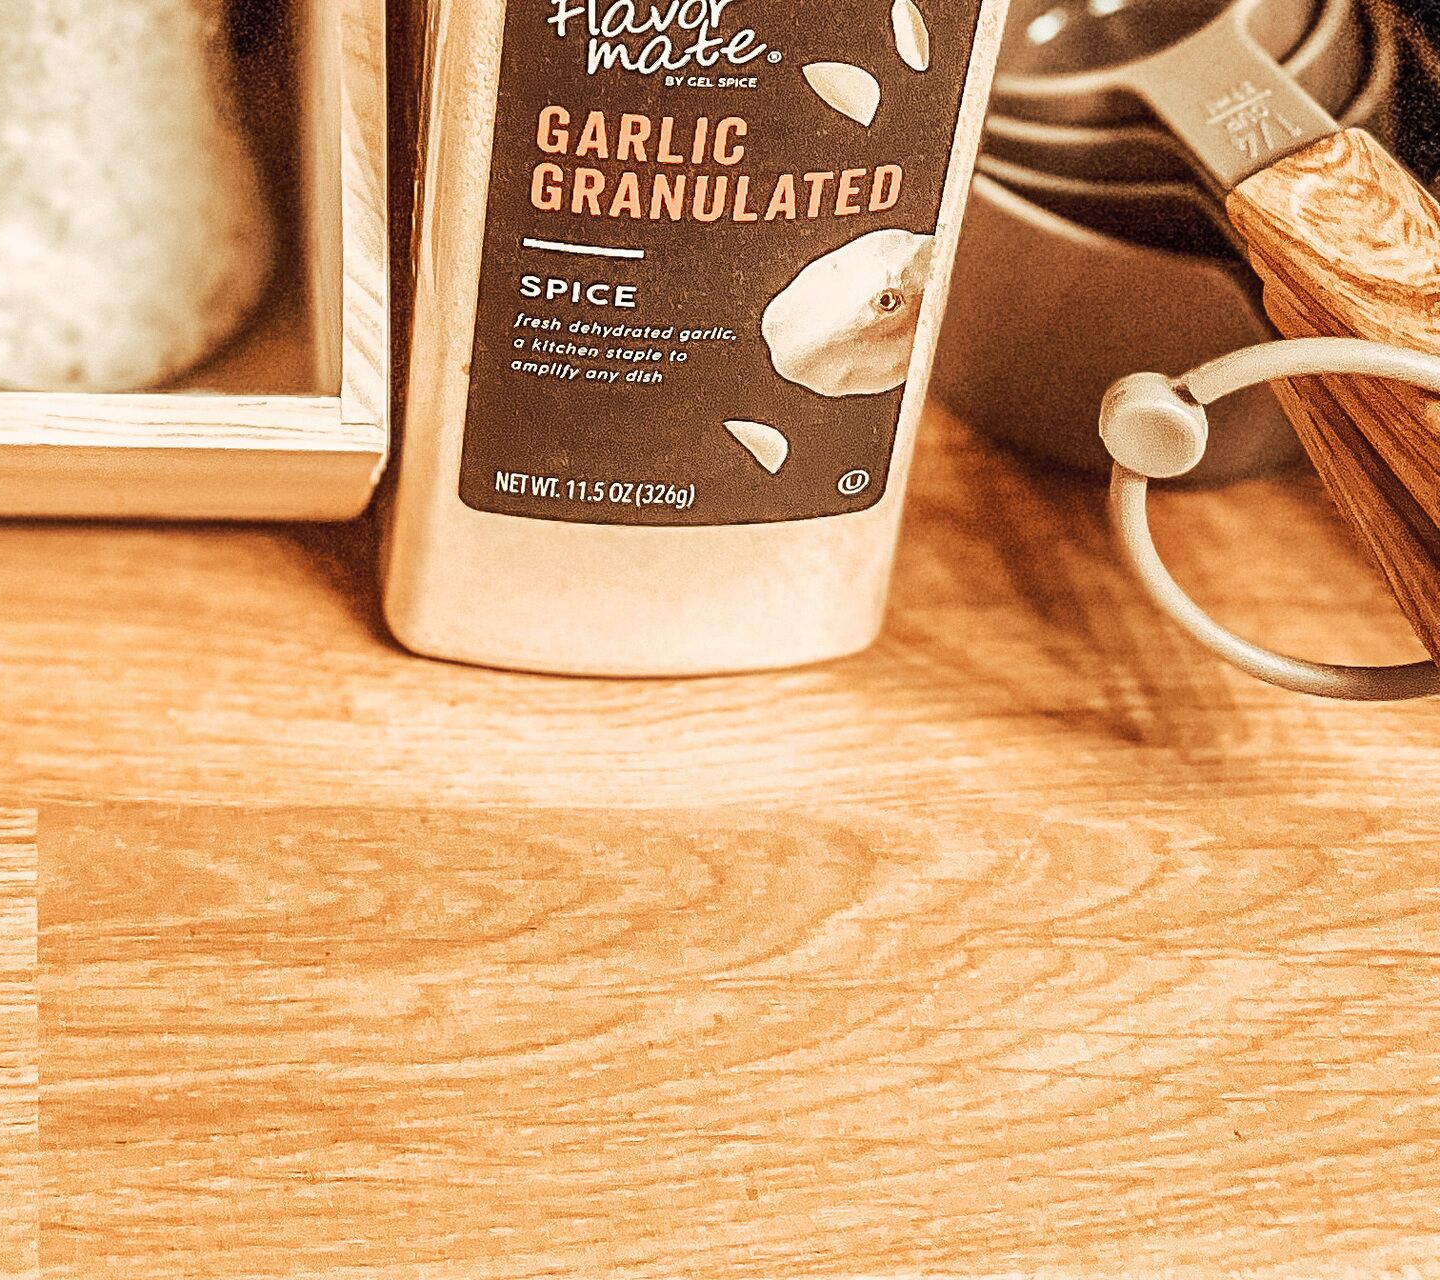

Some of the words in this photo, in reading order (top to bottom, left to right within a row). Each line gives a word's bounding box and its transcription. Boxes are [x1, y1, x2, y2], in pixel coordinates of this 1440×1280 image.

[586, 18, 768, 75] mate
[665, 75, 685, 87] BY
[687, 76, 714, 87] GEL
[718, 76, 758, 88] SPICE
[535, 105, 748, 166] GARLIC
[530, 162, 903, 222] GRANULATED
[519, 275, 638, 308] SPICE
[513, 312, 562, 331] fresh
[568, 320, 674, 340] dehydrated
[513, 338, 526, 349] a
[531, 338, 600, 358] kitchen
[605, 347, 663, 363] staple
[668, 350, 688, 363] to
[510, 359, 580, 380] amplify
[585, 368, 620, 384] any
[625, 369, 664, 384] dish
[494, 470, 528, 494] NET
[529, 475, 561, 500] WT.
[565, 478, 605, 504] 11.5
[634, 483, 696, 510] (326g)
